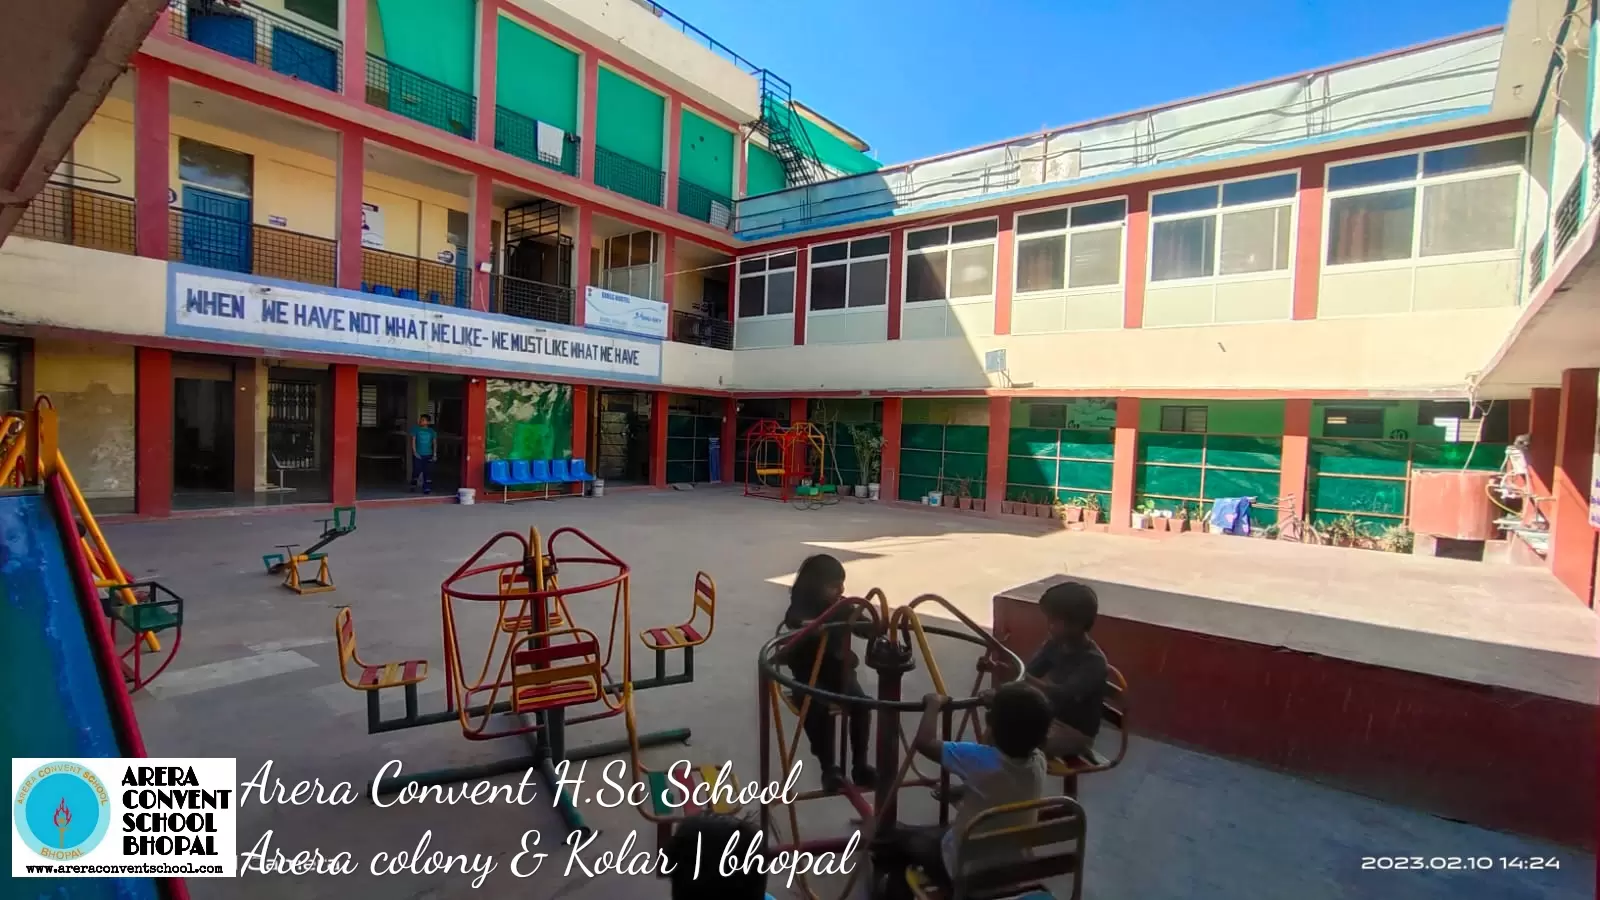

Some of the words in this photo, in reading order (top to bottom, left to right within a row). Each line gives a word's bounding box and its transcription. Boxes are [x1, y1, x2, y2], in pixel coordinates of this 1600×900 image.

[186, 287, 245, 320] WHEN
[261, 299, 289, 325] WE
[294, 303, 345, 332] HAVE
[349, 311, 381, 335] NOT
[385, 315, 429, 342] WHAT
[432, 324, 450, 344] WE
[492, 330, 509, 351] WE
[511, 333, 543, 355] MUST
[545, 336, 569, 357] LIKE
[570, 342, 599, 362] WHAT
[600, 345, 614, 364] WE
[615, 347, 640, 367] HAVE
